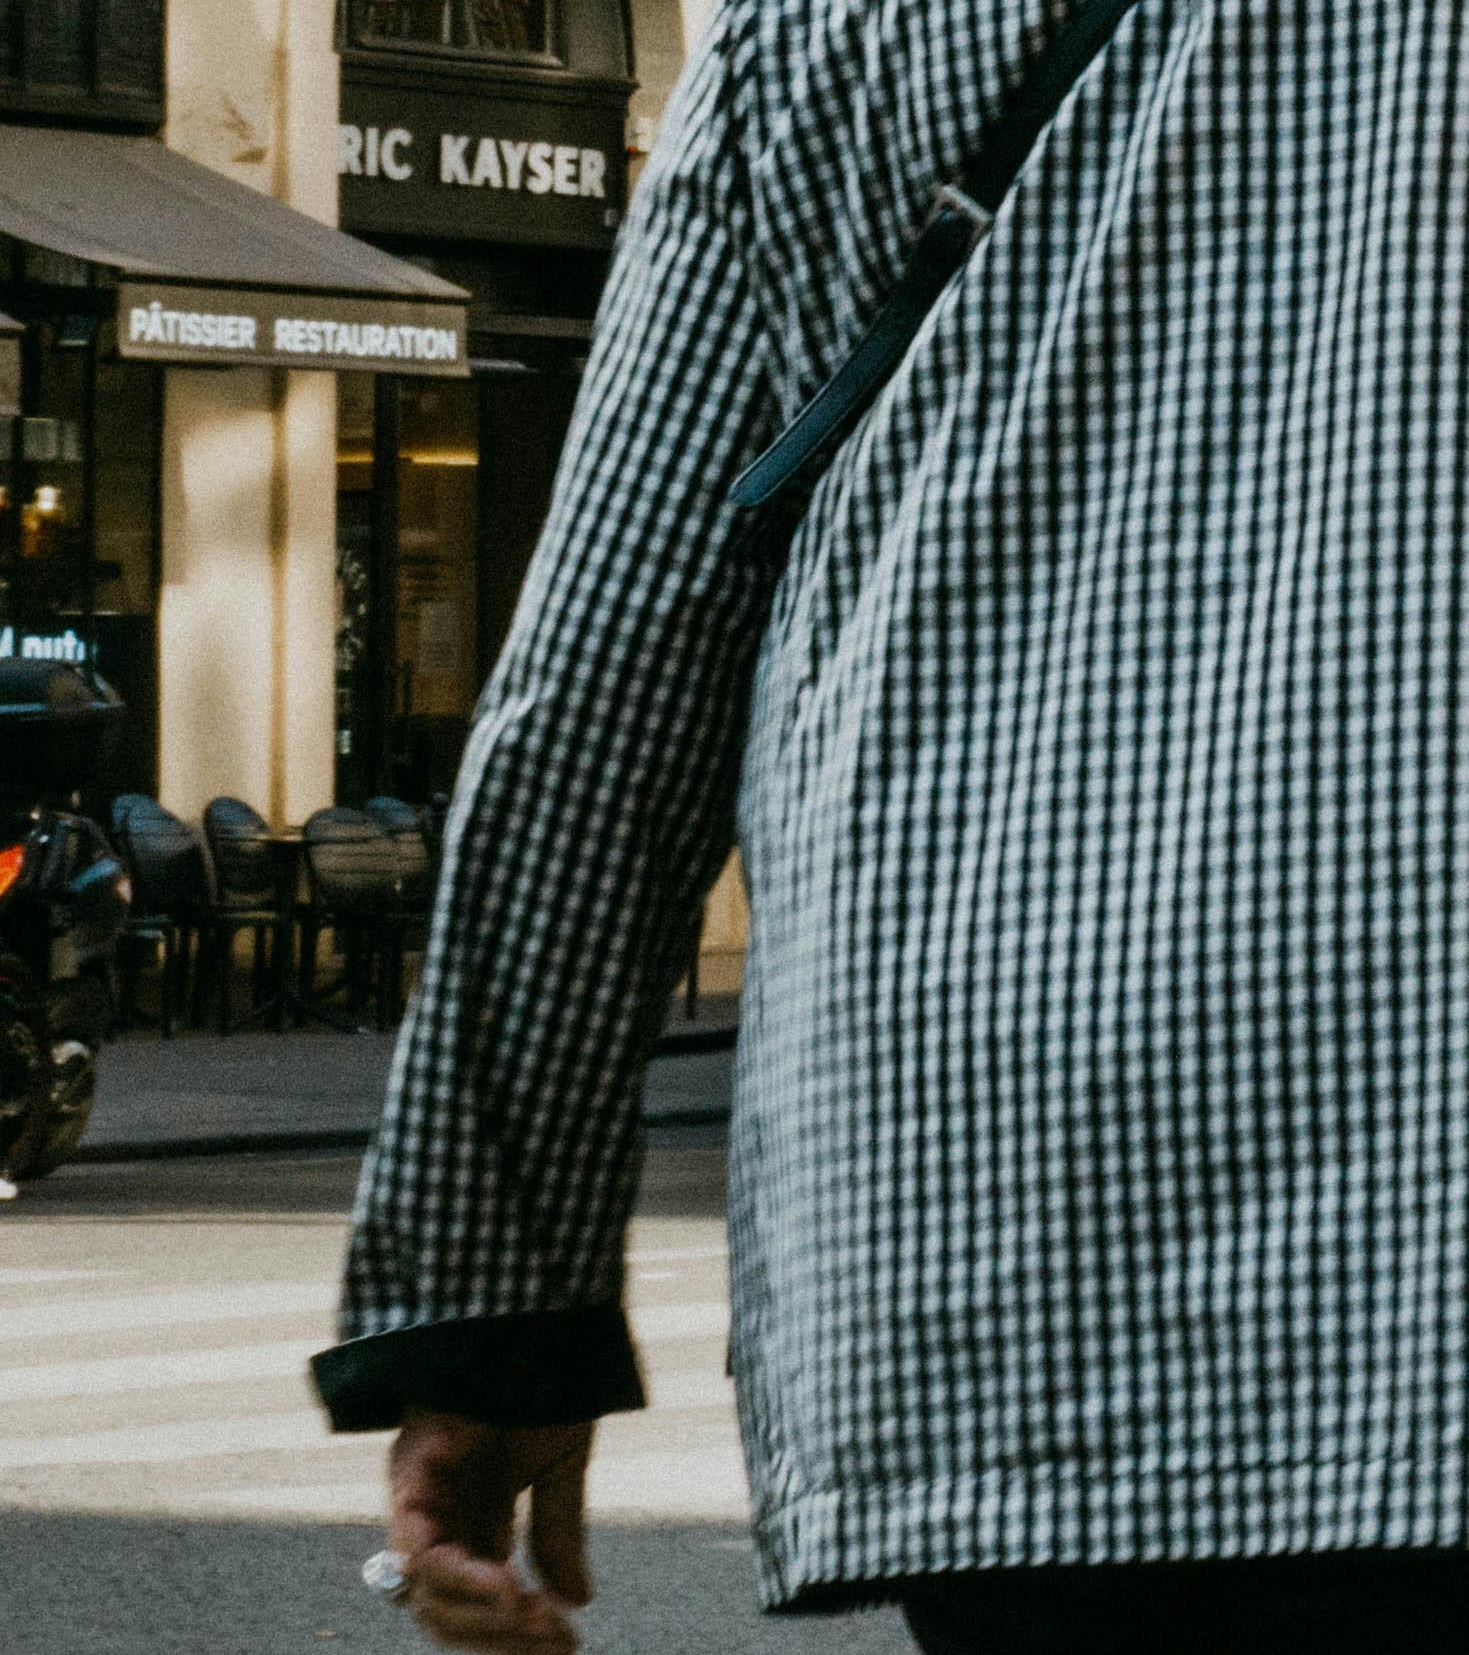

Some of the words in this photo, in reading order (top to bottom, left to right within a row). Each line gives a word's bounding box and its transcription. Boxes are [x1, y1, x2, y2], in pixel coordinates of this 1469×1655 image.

[338, 124, 413, 180] RIC
[440, 134, 606, 198] KAYSER
[129, 301, 256, 349] PÂTISSIER
[273, 318, 457, 360] RESTAURATION
